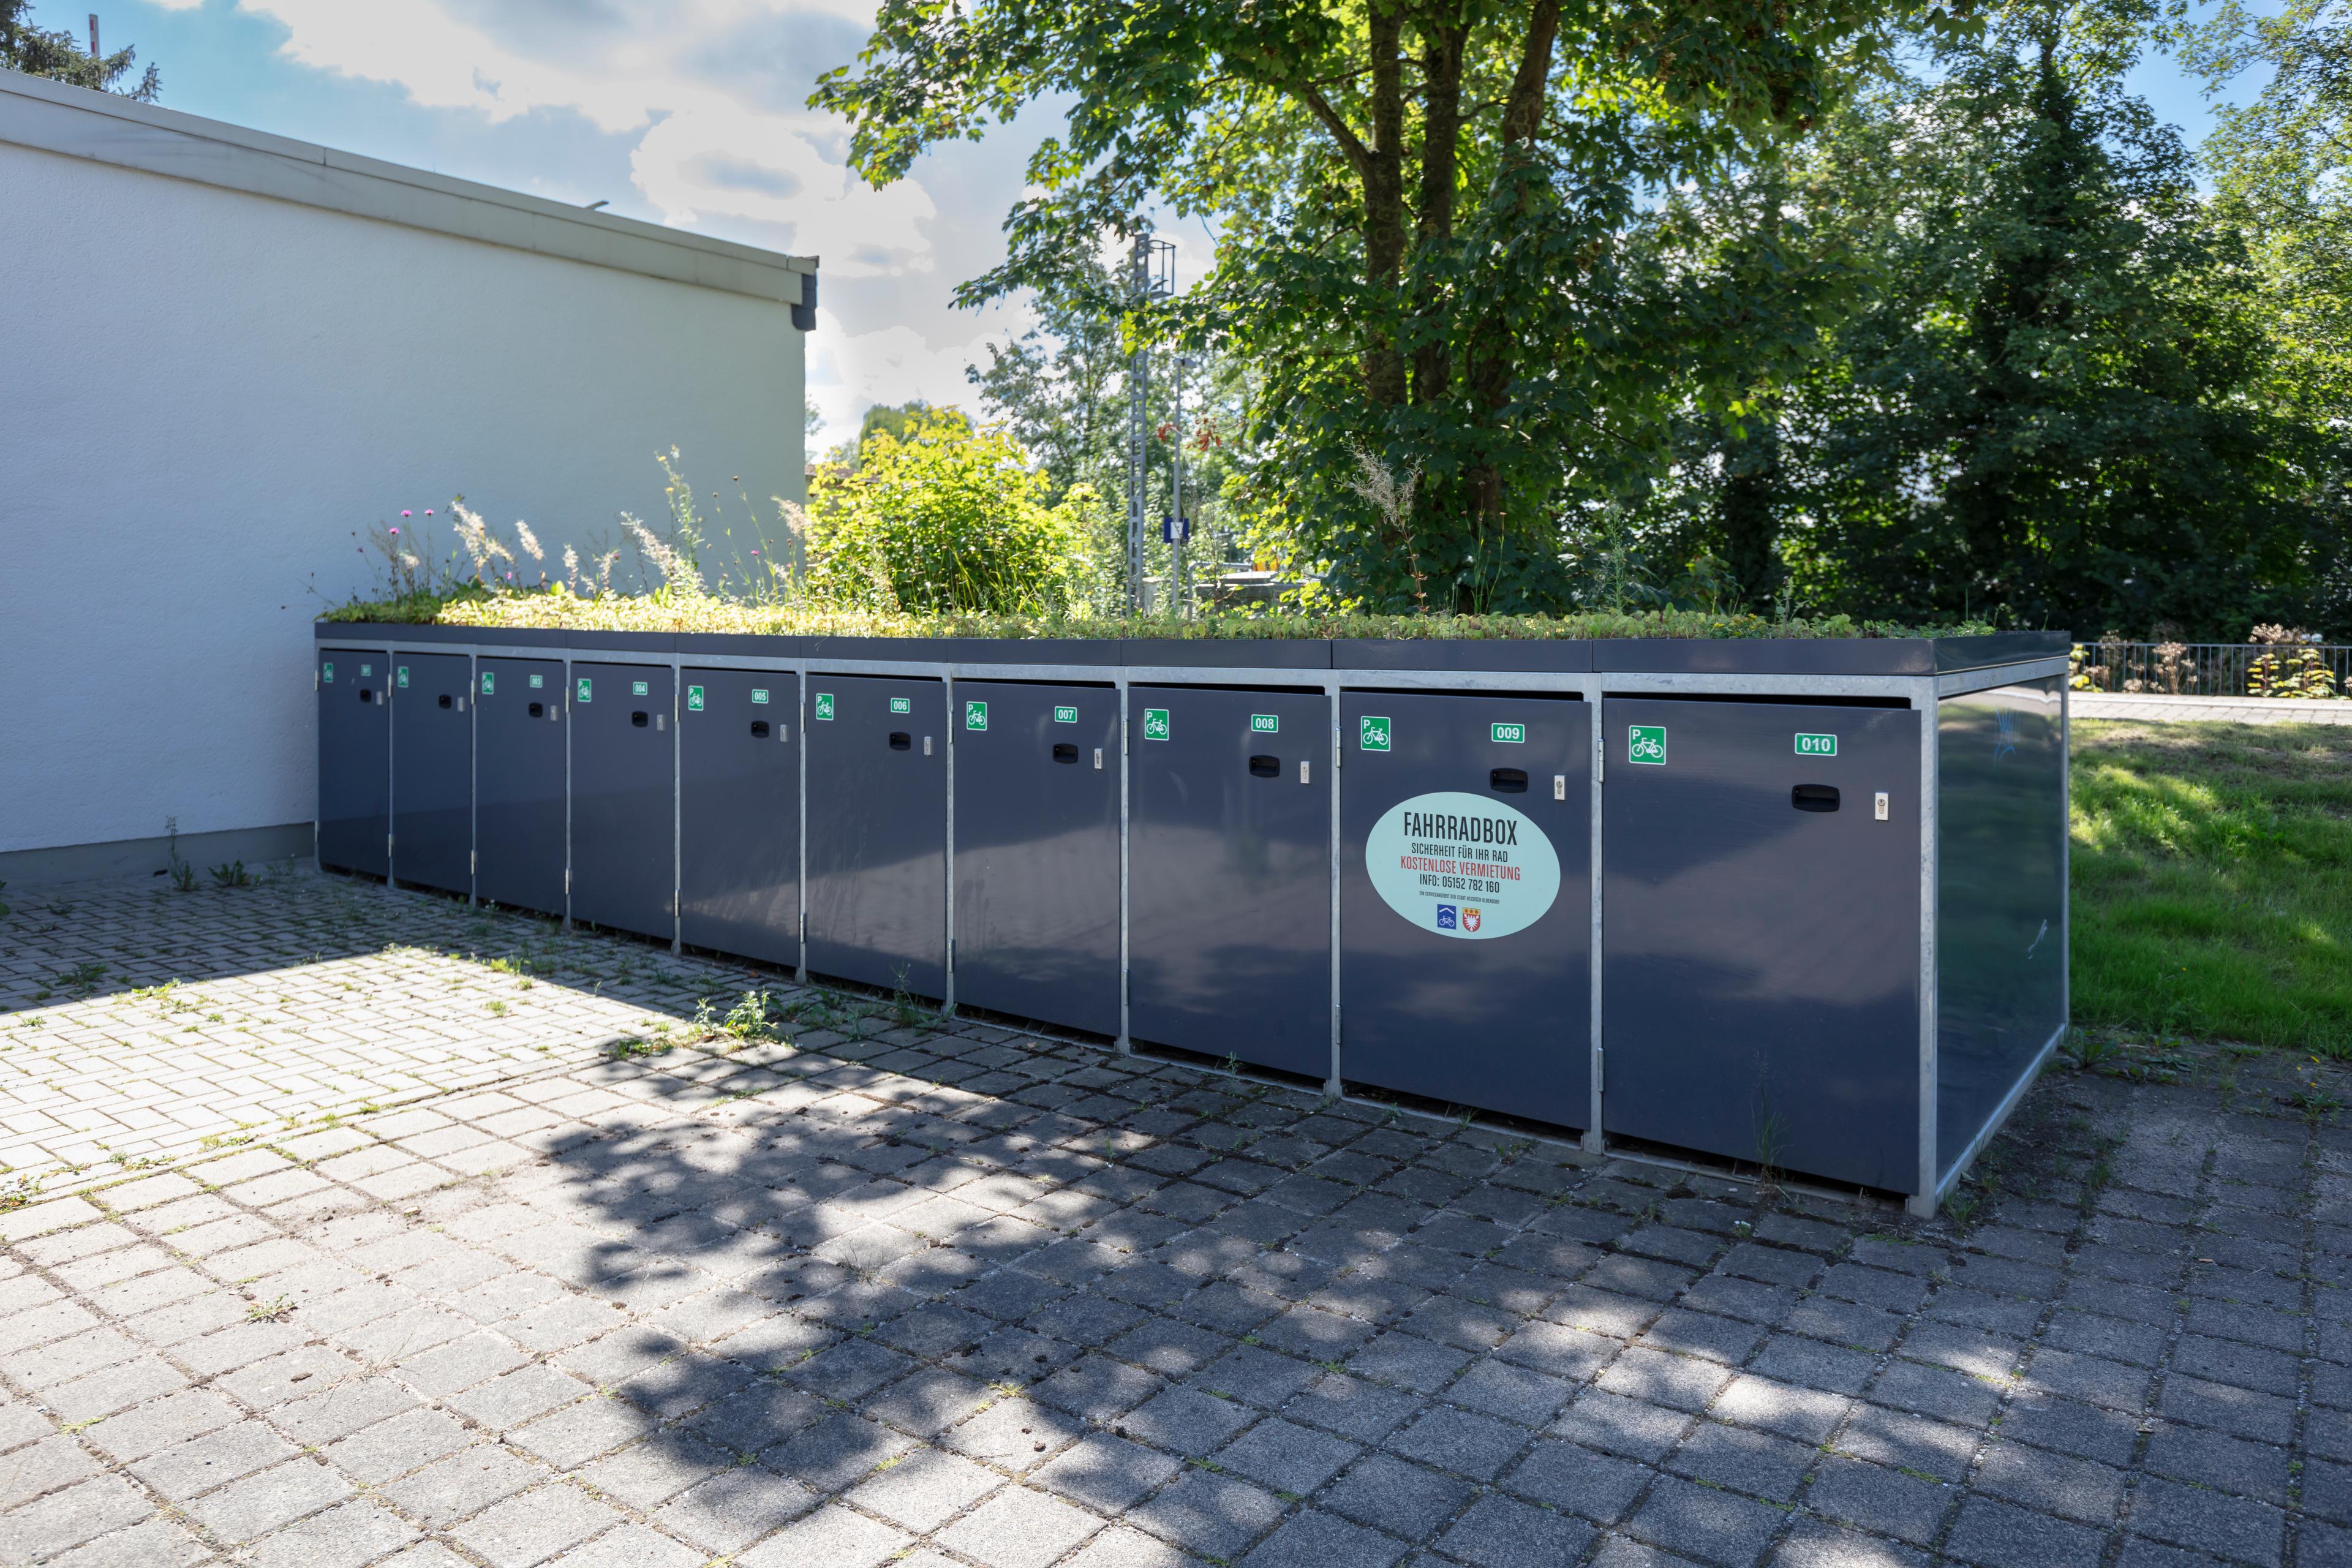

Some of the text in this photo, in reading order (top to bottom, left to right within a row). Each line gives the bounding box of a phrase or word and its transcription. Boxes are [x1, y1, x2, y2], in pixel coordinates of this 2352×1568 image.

[635, 684, 646, 693] 004
[754, 692, 766, 701] 005
[893, 700, 907, 710] 006
[1058, 709, 1074, 720] 007
[1147, 712, 1153, 721] P
[1255, 717, 1274, 729] 008
[1363, 719, 1371, 729] P
[1497, 726, 1520, 739] 009
[1632, 729, 1641, 740] P
[1801, 737, 1831, 752] 010
[1404, 812, 1518, 846] FAHRRADBOX
[1411, 842, 1508, 862] SICHERHEIT FÜR IHR RAD
[1401, 855, 1520, 881] KOSTENLOSE VERMIETUNG
[1420, 873, 1499, 893] INFO: 05152 782 160
